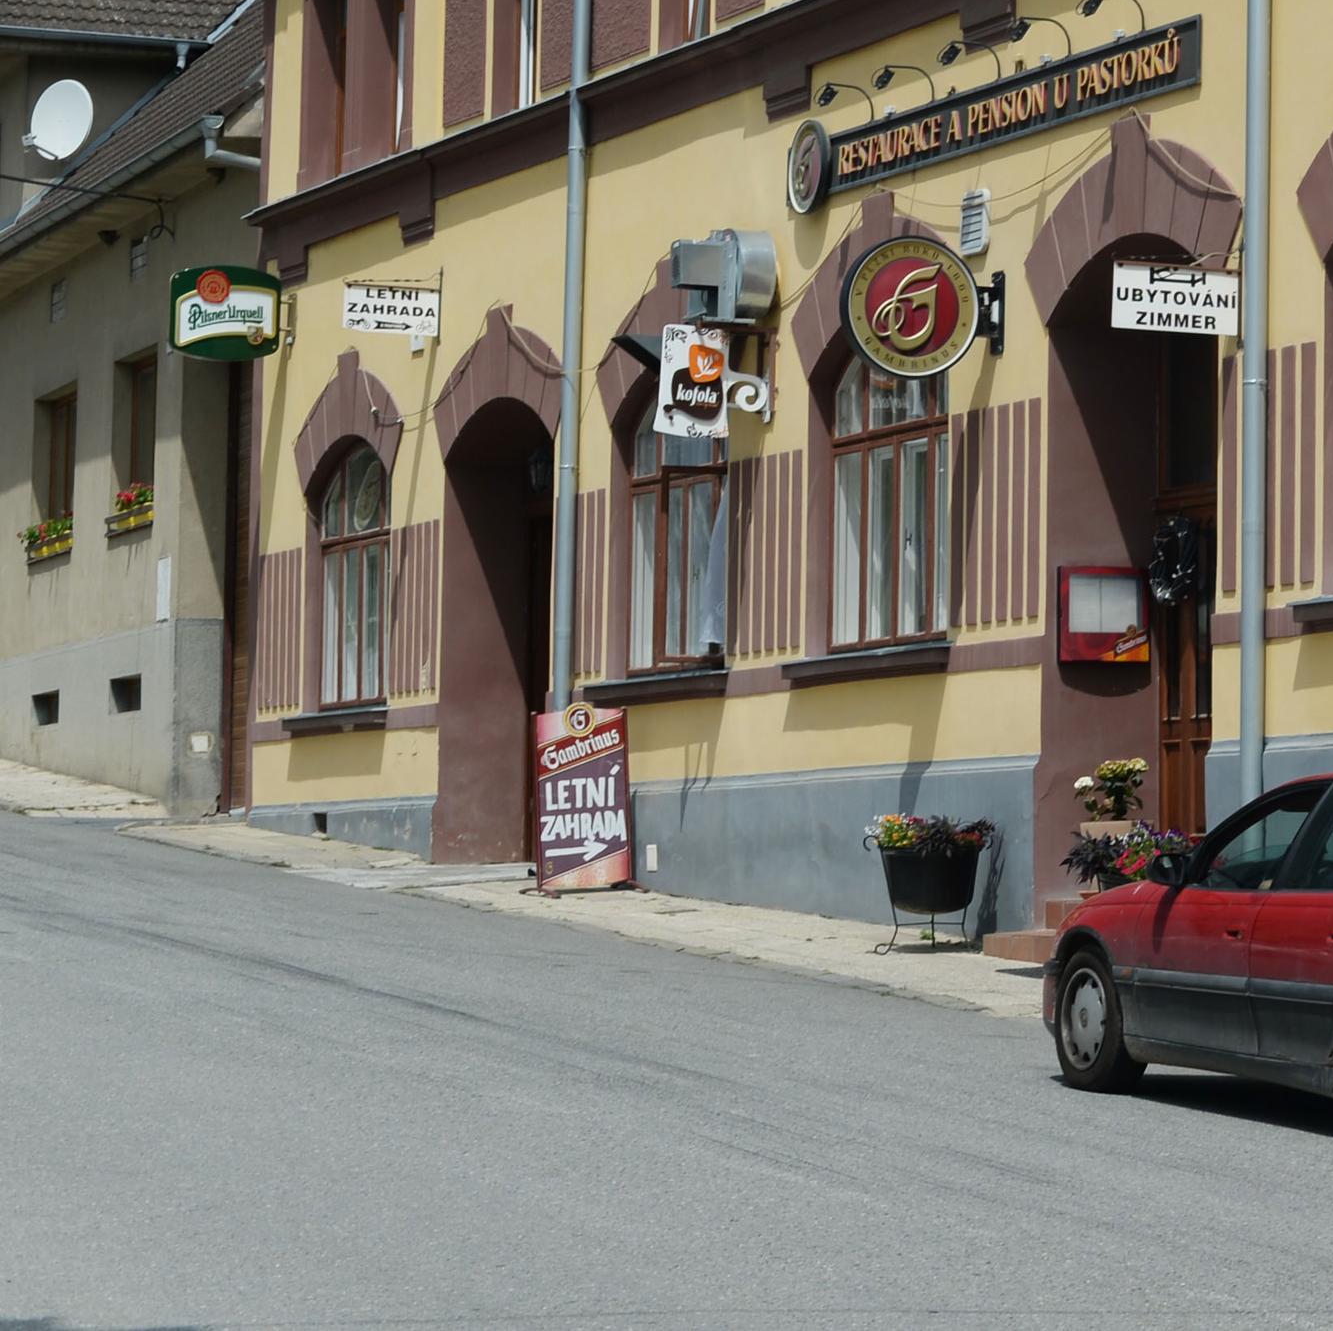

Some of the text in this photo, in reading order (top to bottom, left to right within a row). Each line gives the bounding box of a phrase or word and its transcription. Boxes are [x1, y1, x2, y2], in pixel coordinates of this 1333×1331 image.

[837, 28, 1182, 176] RESTAURACE A PENSION U PASTORKŮ
[346, 301, 436, 318] ZAHRADA
[1116, 286, 1237, 310] UBYTOVÁNÍ
[1135, 310, 1217, 330] ZIMMER
[675, 383, 719, 407] kofola
[541, 729, 620, 770] Gambrinus
[545, 764, 621, 811] LETNÍ
[540, 809, 628, 843] ZAHRADA
